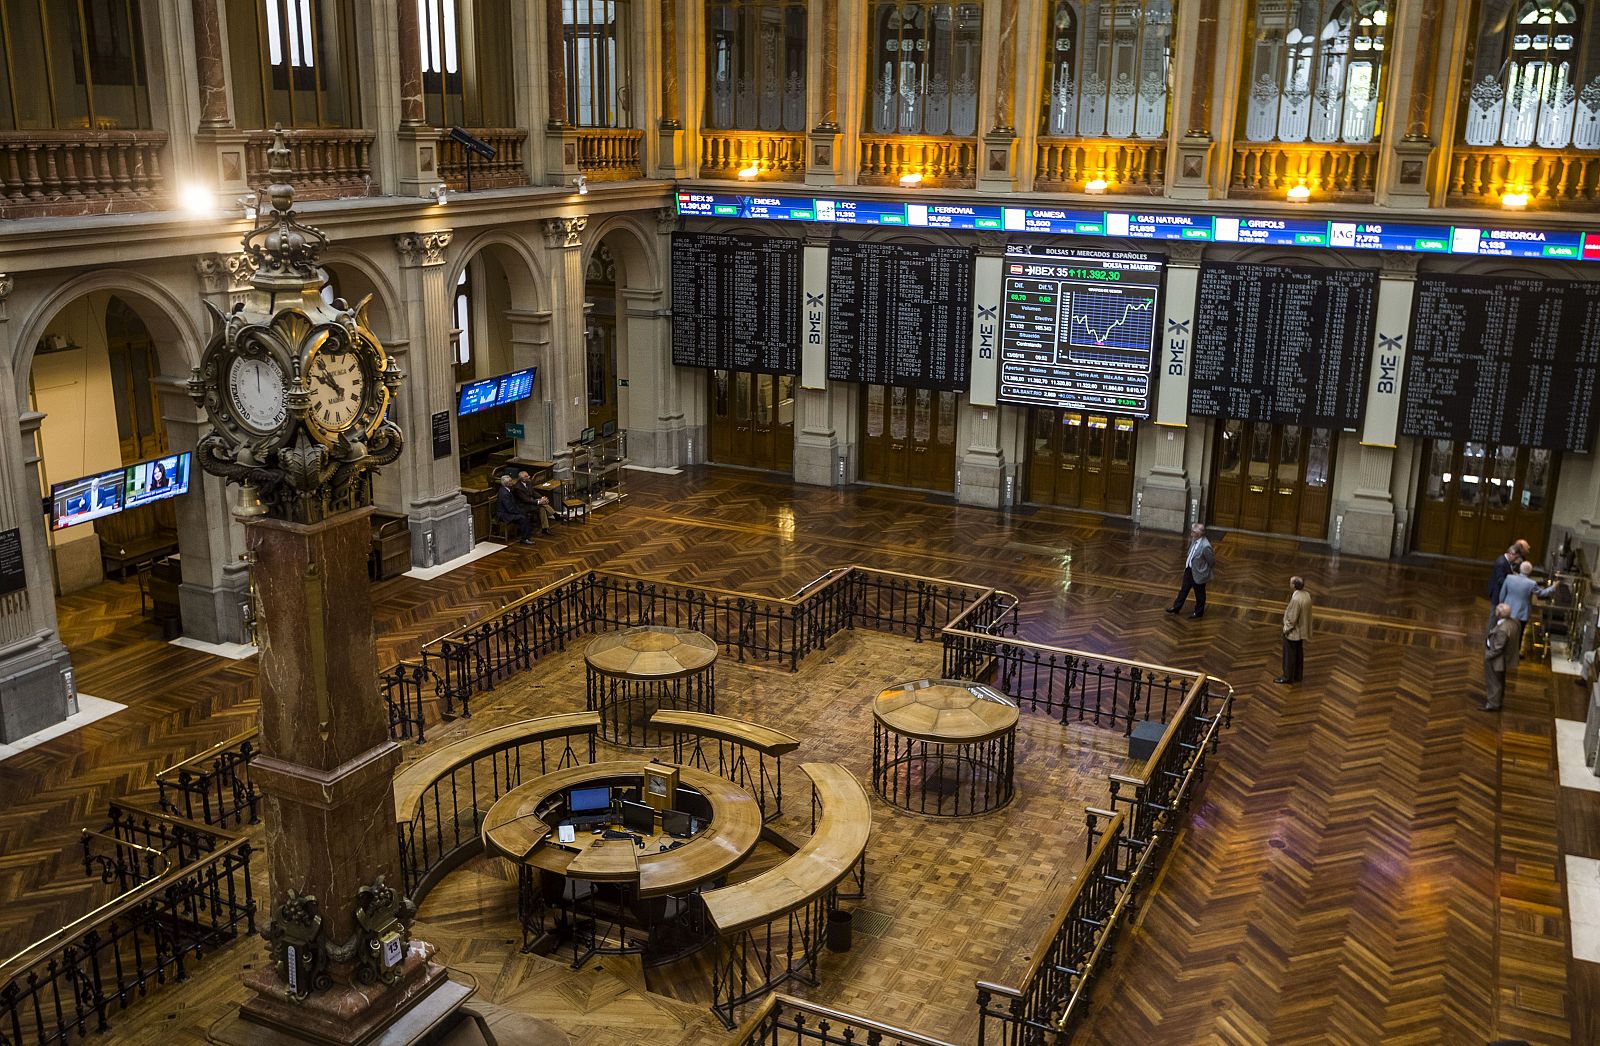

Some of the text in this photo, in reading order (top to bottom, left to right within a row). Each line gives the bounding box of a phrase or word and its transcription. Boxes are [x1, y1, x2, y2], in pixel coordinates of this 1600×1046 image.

[1156, 217, 1193, 225] NATURAL
[1332, 229, 1353, 239] IAG
[1491, 231, 1546, 240] IBERDROLA
[1113, 252, 1147, 260] ESPAÑOLES
[1033, 267, 1120, 280] IBEX 35 11.392,30
[809, 311, 820, 344] BME
[979, 324, 993, 359] BME
[1169, 339, 1184, 376] BME
[1378, 355, 1396, 394] BME
[231, 384, 250, 420] TEMPESTAD
[388, 941, 398, 953] 13
